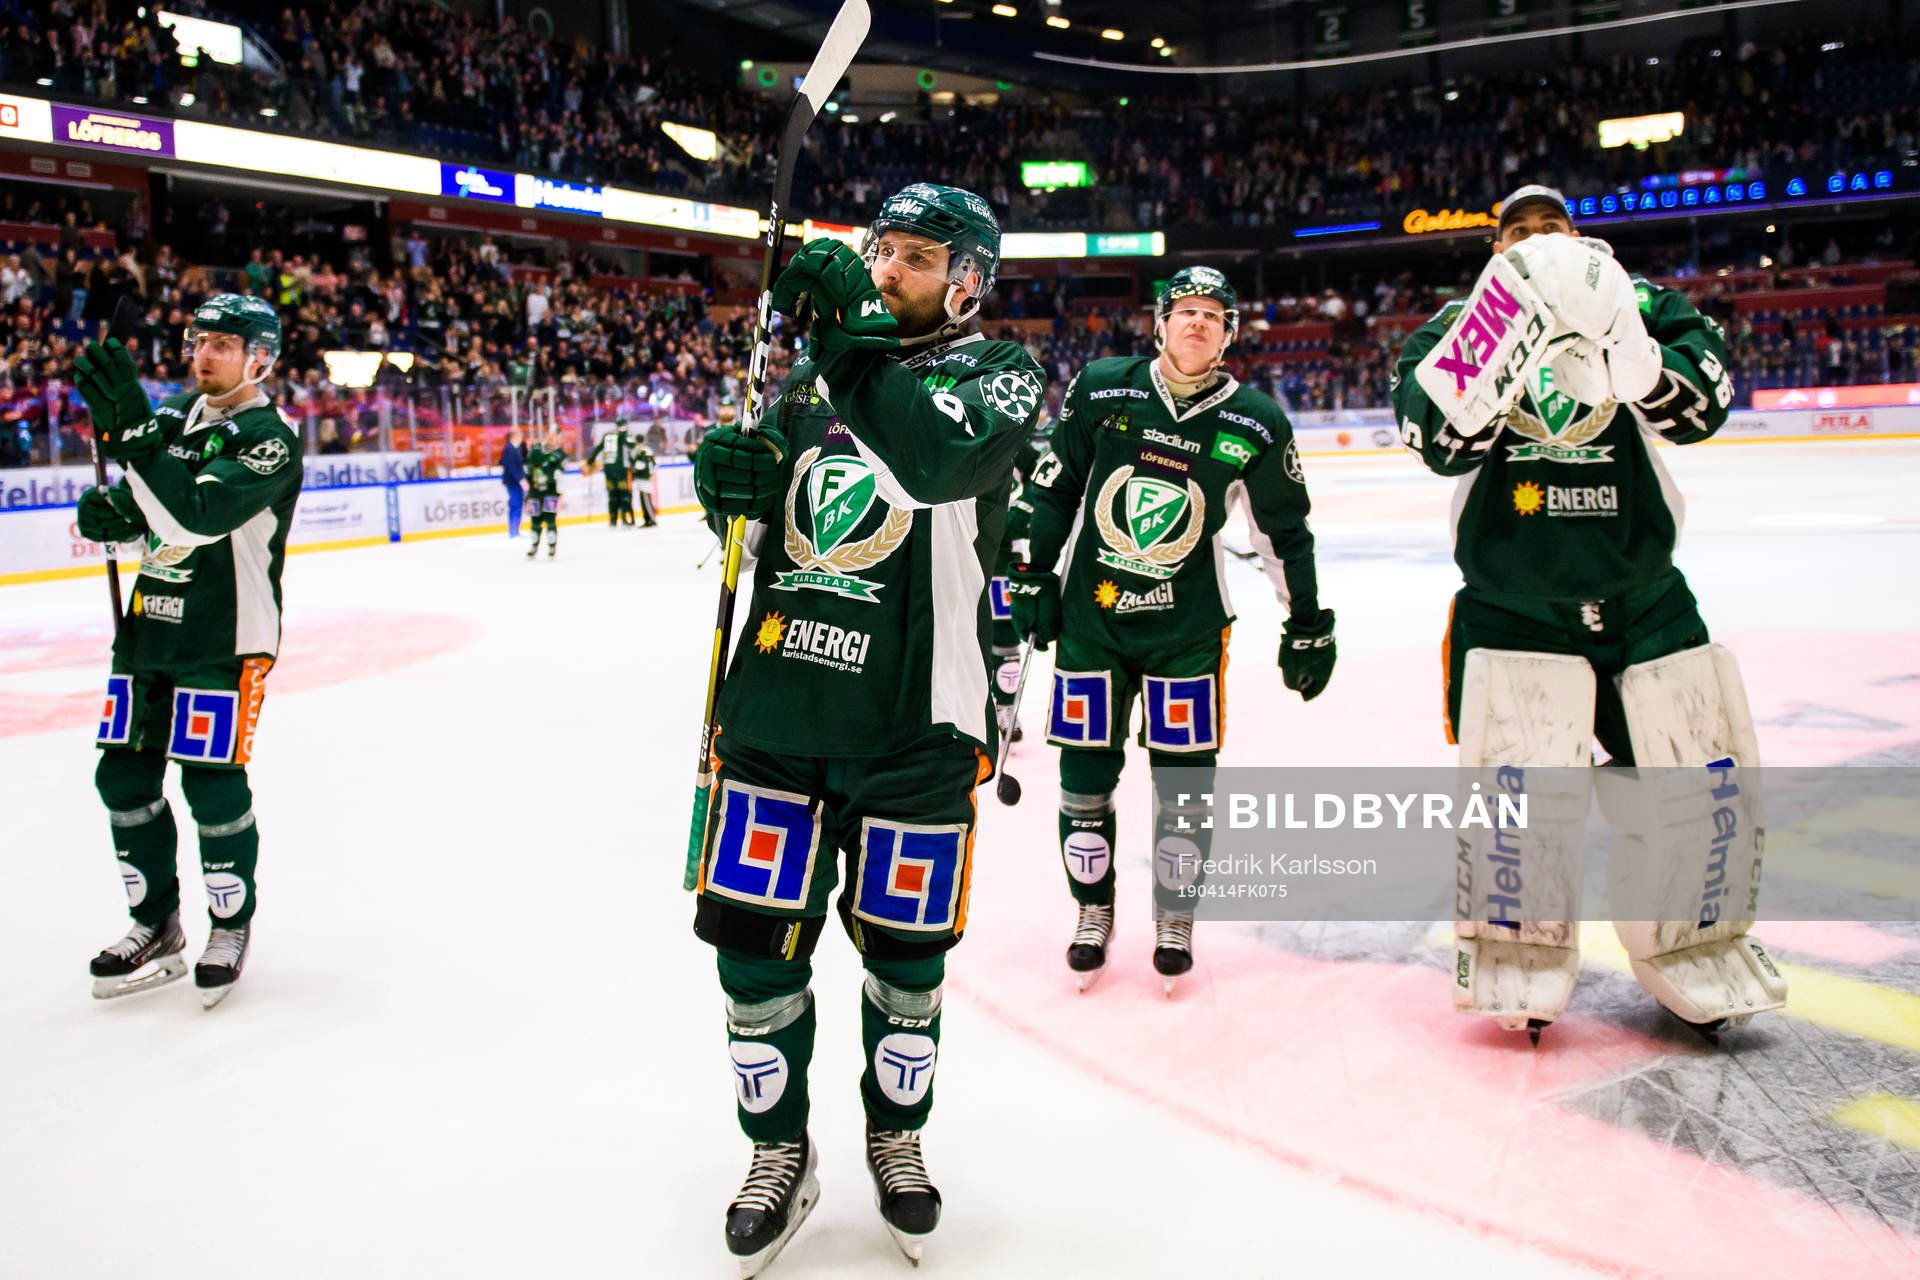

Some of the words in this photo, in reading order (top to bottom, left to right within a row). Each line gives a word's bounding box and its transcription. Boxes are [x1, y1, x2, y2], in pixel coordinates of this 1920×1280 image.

[767, 200, 779, 247] CCM
[1403, 208, 1487, 234] Golden
[976, 245, 995, 259] CCM
[1494, 313, 1547, 399] CCM
[1089, 388, 1151, 401] MOEEN
[1142, 428, 1201, 454] stadium
[1140, 451, 1189, 473] LÖFBERGS
[819, 469, 846, 506] F
[1136, 487, 1160, 513] F
[1547, 485, 1619, 510] ENERGI
[424, 500, 506, 523] LÖFBERG
[822, 491, 857, 535] BK
[1140, 507, 1167, 536] BK
[793, 574, 851, 588] KARLSTAD
[784, 619, 871, 665] ENERGI
[1292, 633, 1334, 649] CC
[782, 649, 862, 674] karlstadsenergi.se
[700, 722, 711, 762] CCM
[1071, 819, 1104, 828] CCM
[1457, 835, 1473, 921] CCM
[1746, 827, 1766, 911] CCM
[729, 1024, 771, 1036] CCM
[887, 1016, 933, 1029] CCM
